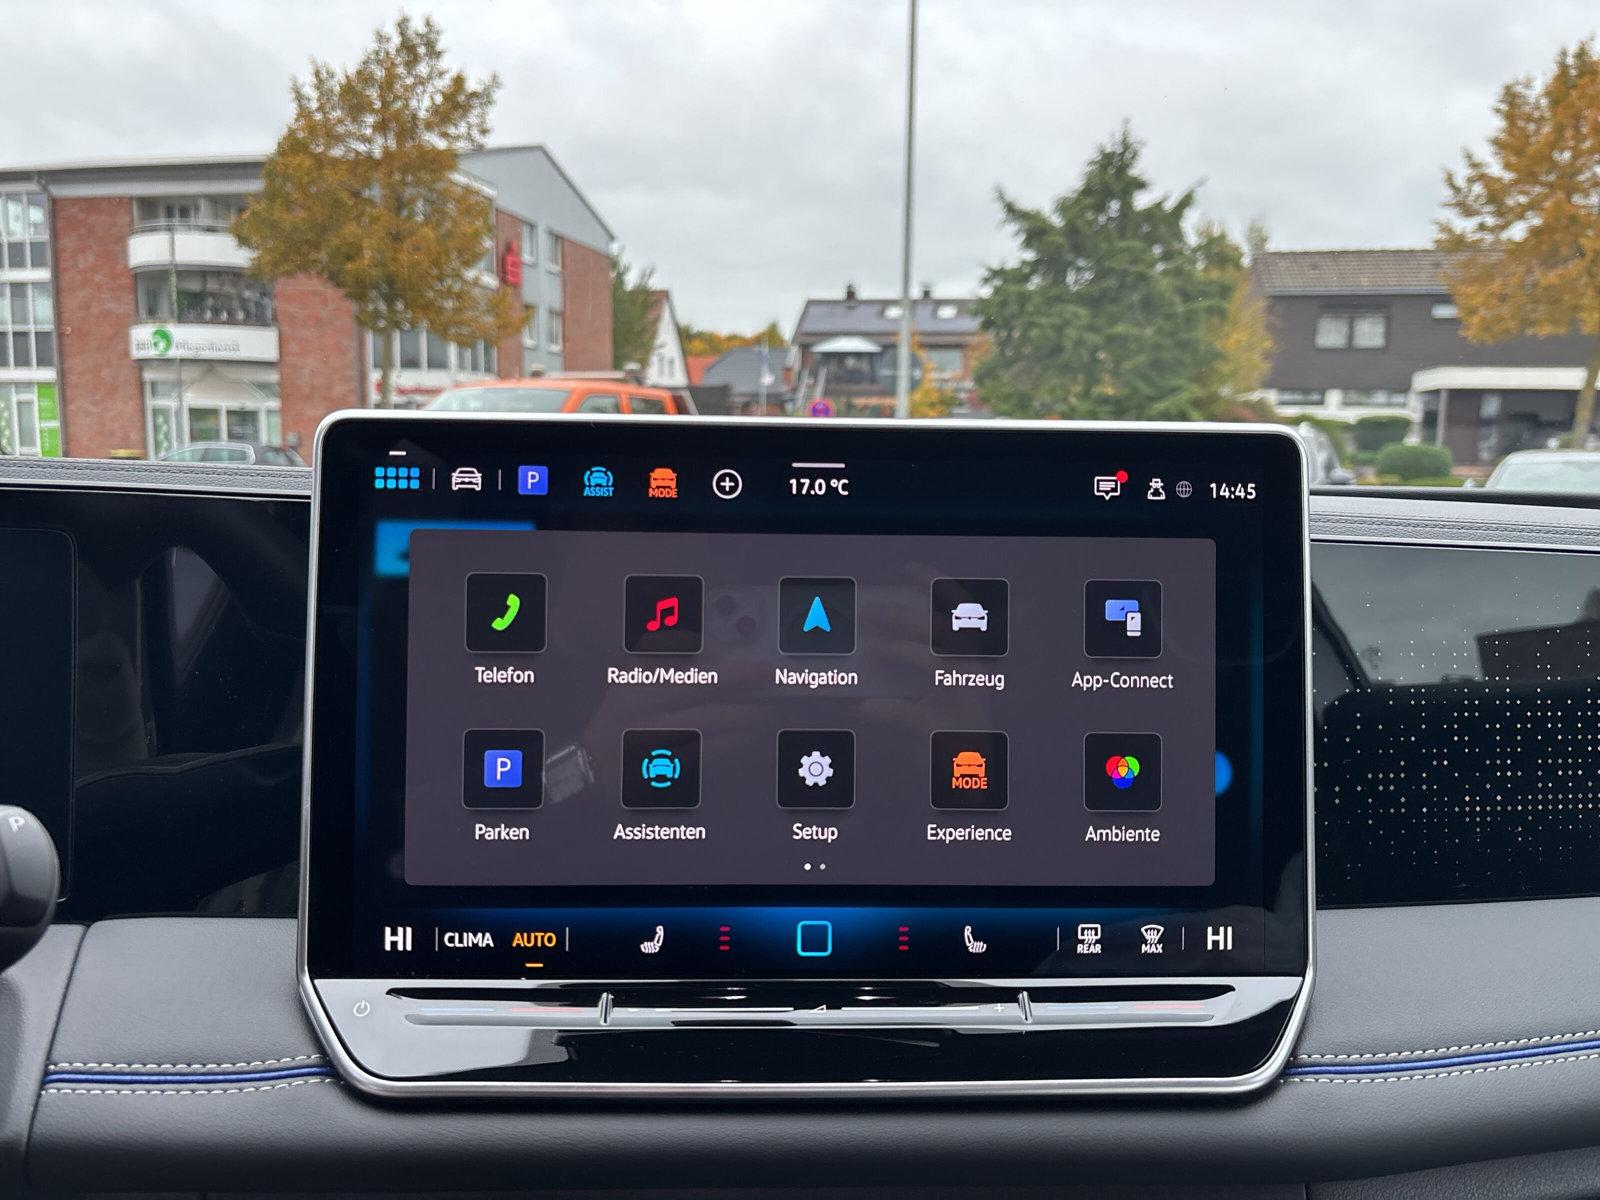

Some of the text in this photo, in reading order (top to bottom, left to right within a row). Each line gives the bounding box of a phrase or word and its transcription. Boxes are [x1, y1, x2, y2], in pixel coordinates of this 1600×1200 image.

[527, 471, 540, 490] P
[789, 478, 850, 496] 17.0 °C
[583, 486, 615, 498] ASSIST
[648, 487, 679, 499] MODE
[1209, 482, 1257, 501] 14:45
[474, 666, 535, 684] Telefon
[607, 666, 719, 685] Radio/Medien
[775, 667, 858, 689] Navigation
[934, 669, 1005, 691] Fahrzeug
[1071, 671, 1174, 692] App-Connect
[496, 757, 512, 781] P
[951, 776, 988, 790] MODE
[8, 816, 26, 833] P
[474, 823, 530, 841] Parken
[613, 823, 706, 841] Assistenten
[792, 822, 839, 844] Setup
[926, 823, 1013, 844] Experience
[1084, 825, 1161, 843] Ambiente
[384, 926, 412, 952] HI
[443, 931, 495, 948] CLIMA
[512, 931, 557, 948] AUTO
[1206, 926, 1233, 951] HI
[1076, 942, 1102, 954] REAR
[1141, 942, 1163, 954] MAX
